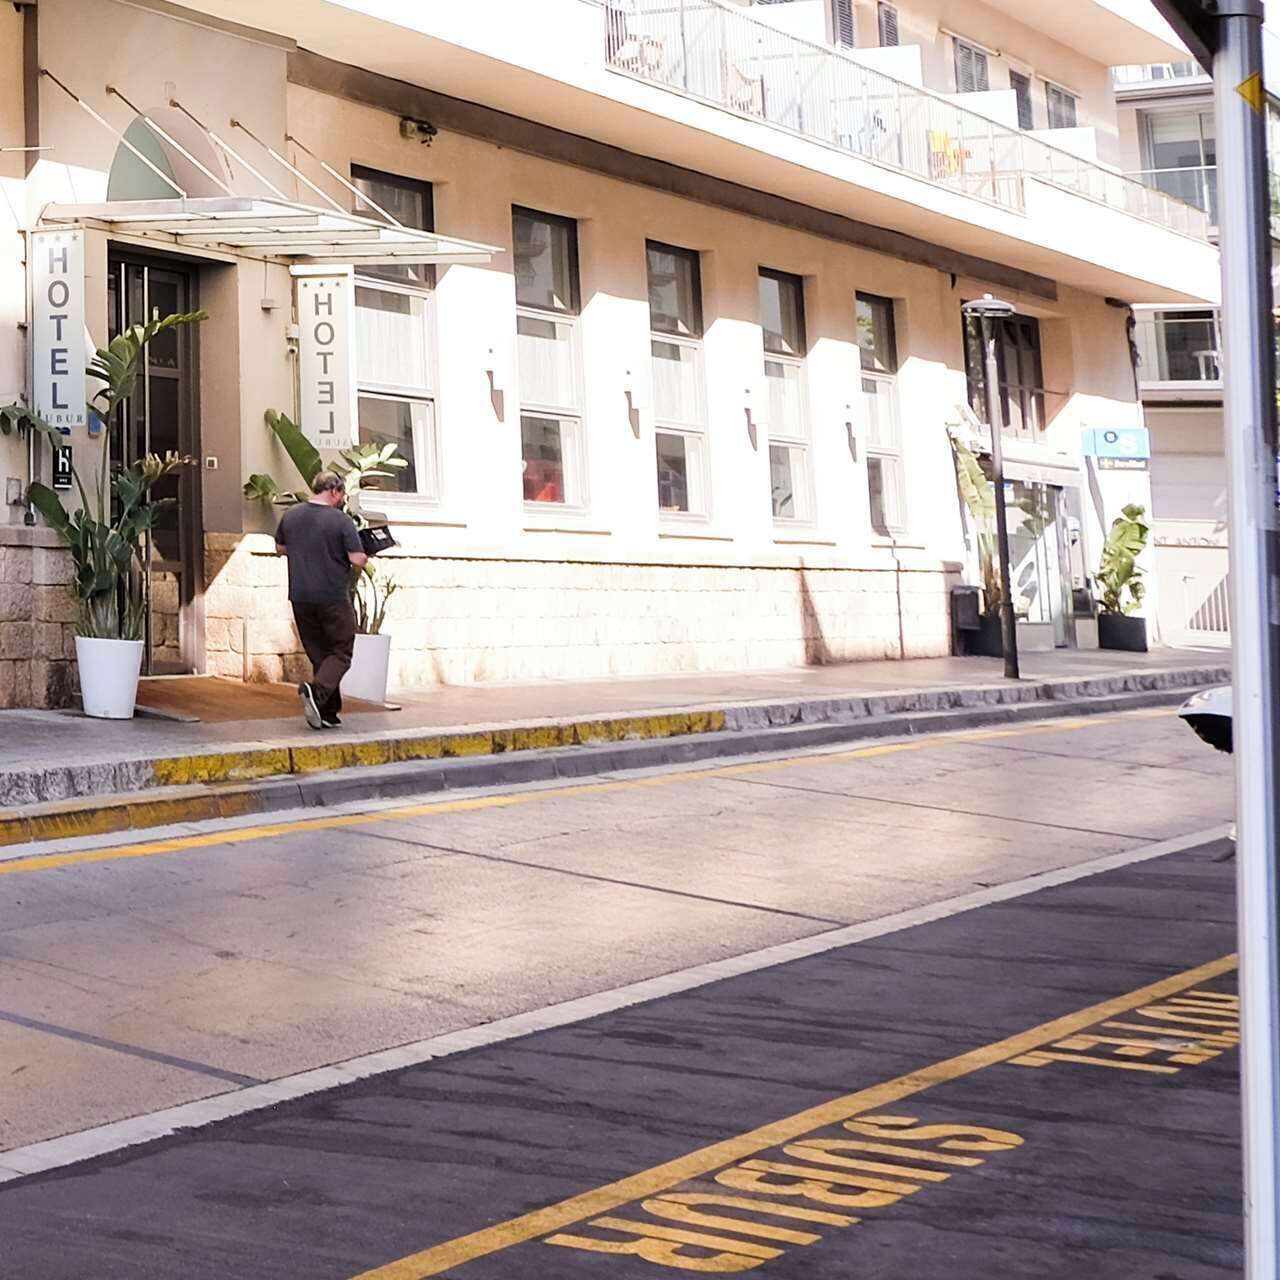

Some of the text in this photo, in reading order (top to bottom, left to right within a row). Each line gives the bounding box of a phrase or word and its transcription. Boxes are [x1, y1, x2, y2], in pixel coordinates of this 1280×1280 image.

[48, 247, 70, 410] HOTEL
[45, 414, 84, 424] UBUR
[544, 1116, 1025, 1273] SUBUR
